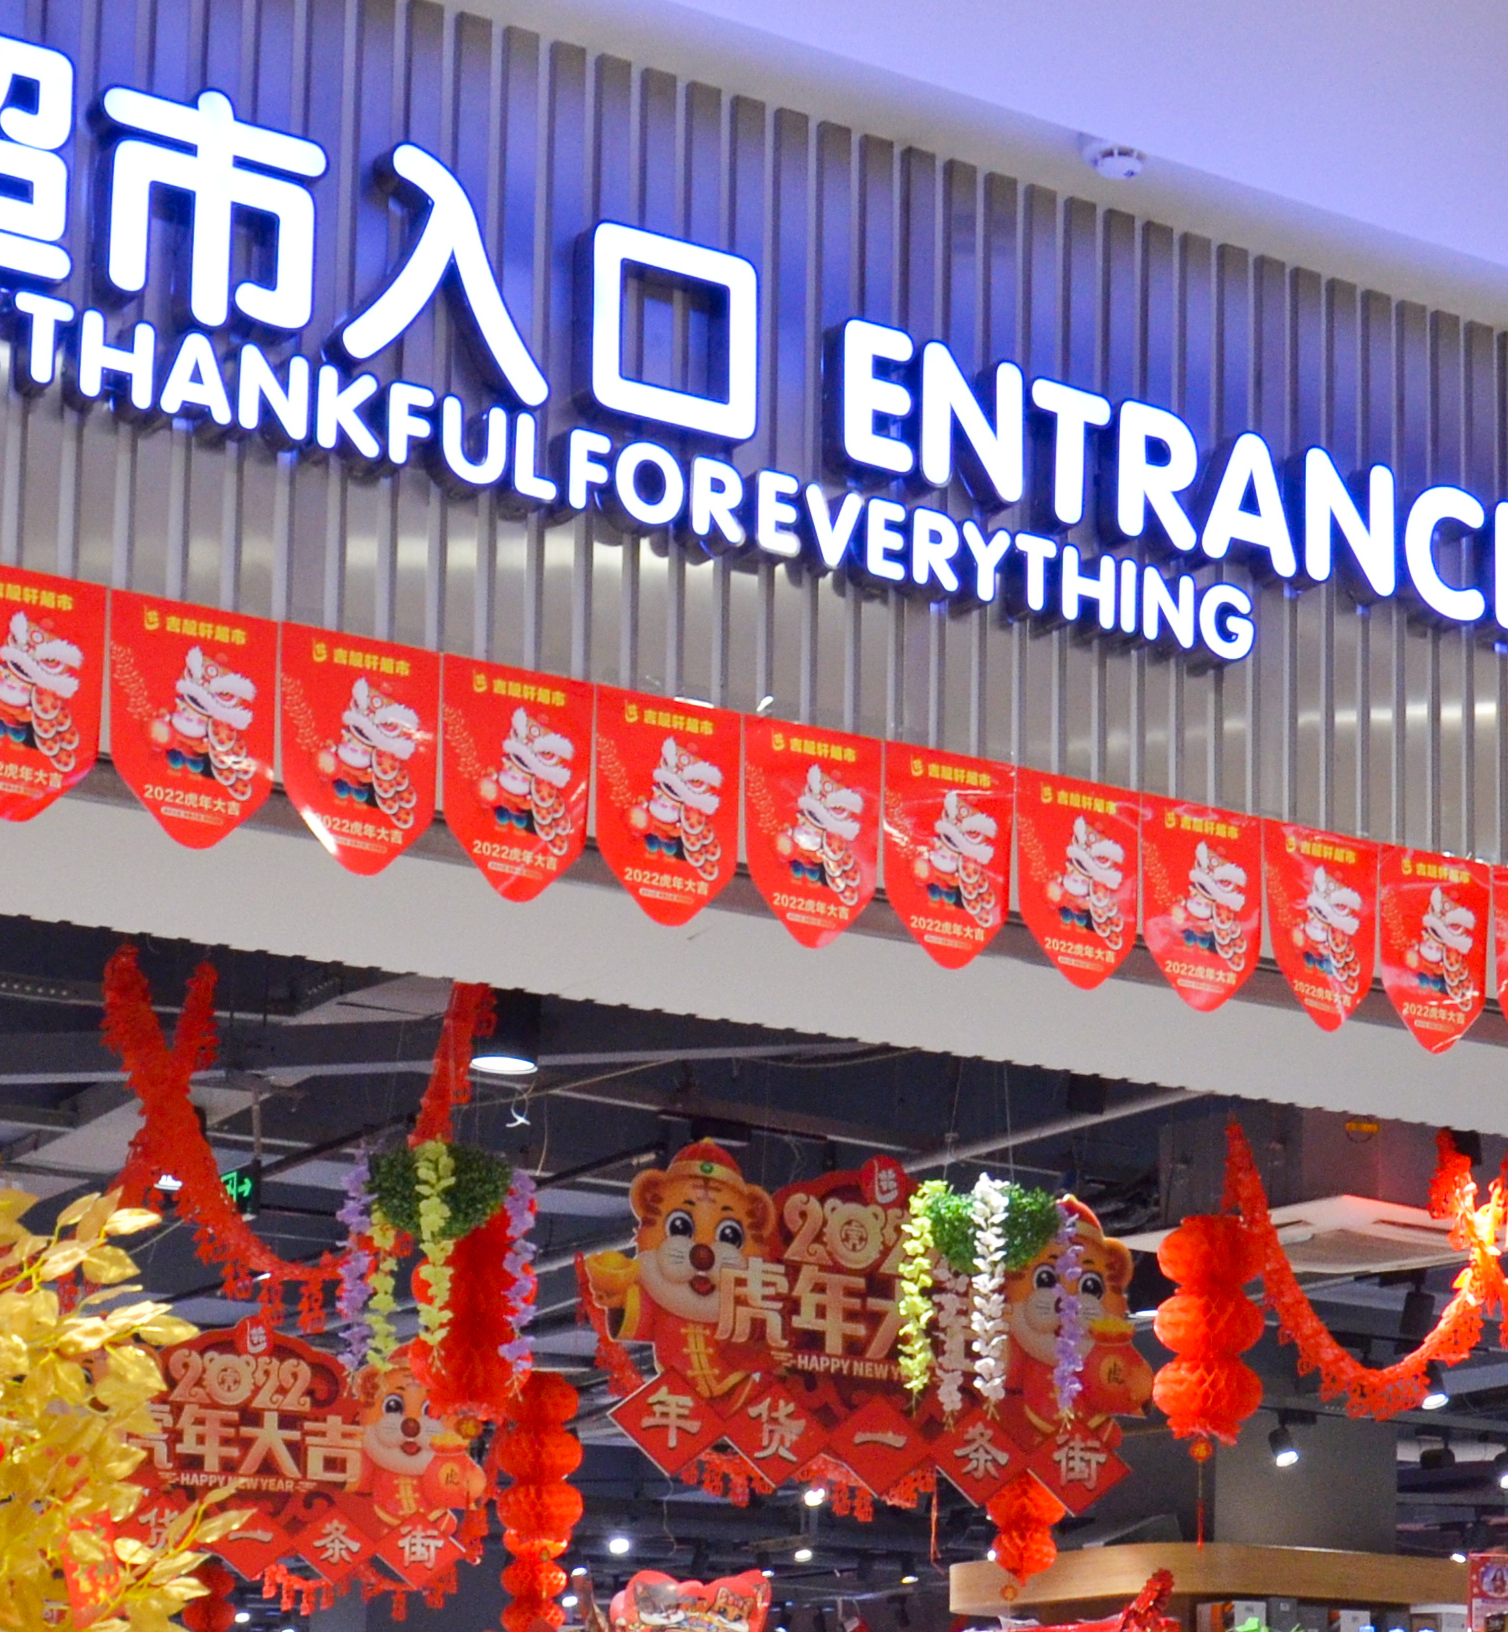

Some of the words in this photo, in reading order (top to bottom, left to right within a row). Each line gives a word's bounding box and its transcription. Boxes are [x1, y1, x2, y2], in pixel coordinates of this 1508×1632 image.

[169, 1349, 312, 1412] 2022
[796, 1353, 850, 1374] HAPPY
[853, 1358, 889, 1377] NEW
[640, 1387, 1108, 1490] 年货一条街
[181, 1472, 225, 1488] HAPPY
[261, 1477, 295, 1492] YEAR
